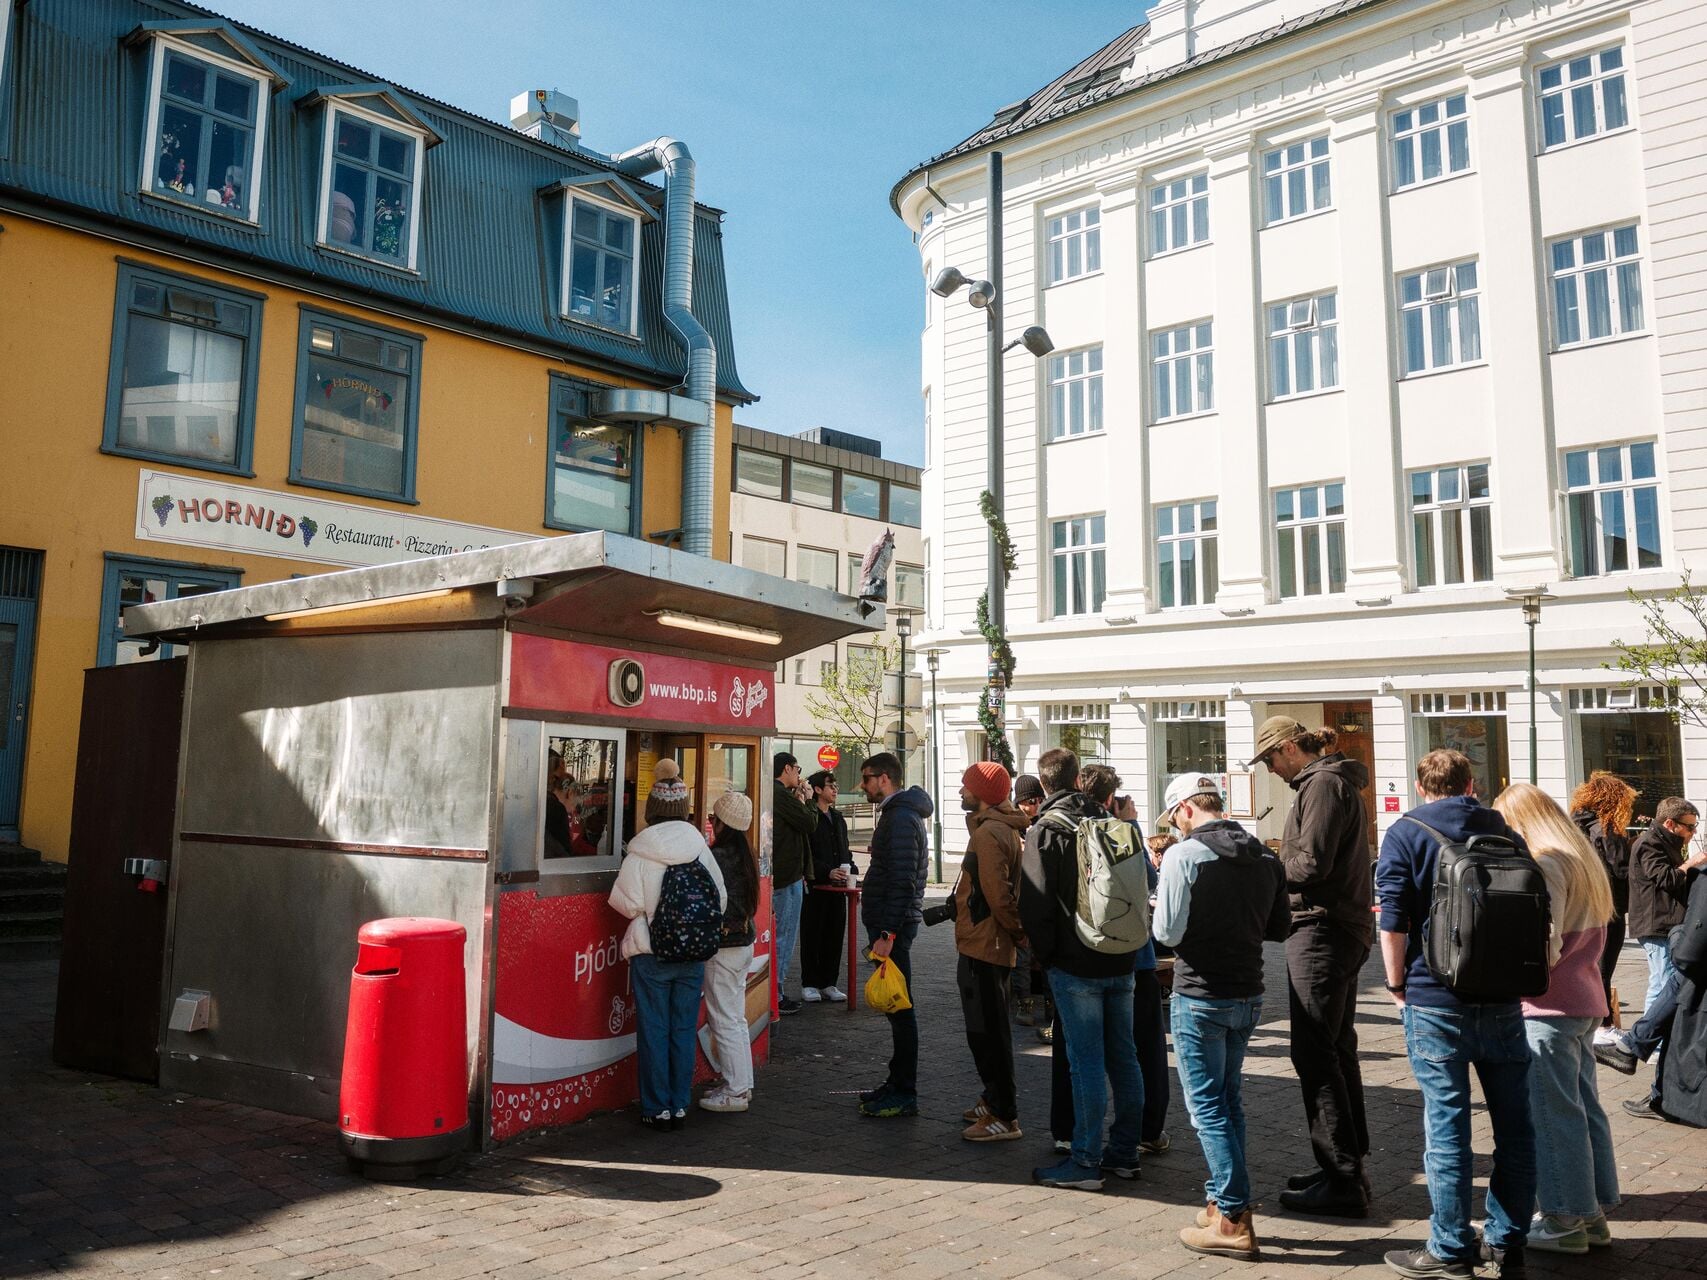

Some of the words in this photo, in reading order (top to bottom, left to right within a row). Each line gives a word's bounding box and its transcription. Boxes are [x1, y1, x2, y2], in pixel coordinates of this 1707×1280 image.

[177, 498, 296, 539] HORNIÐ
[325, 523, 394, 549] Restaurant
[649, 683, 717, 705] www.bbp.is
[1388, 781, 1396, 792] 2
[574, 934, 625, 985] þjóð
